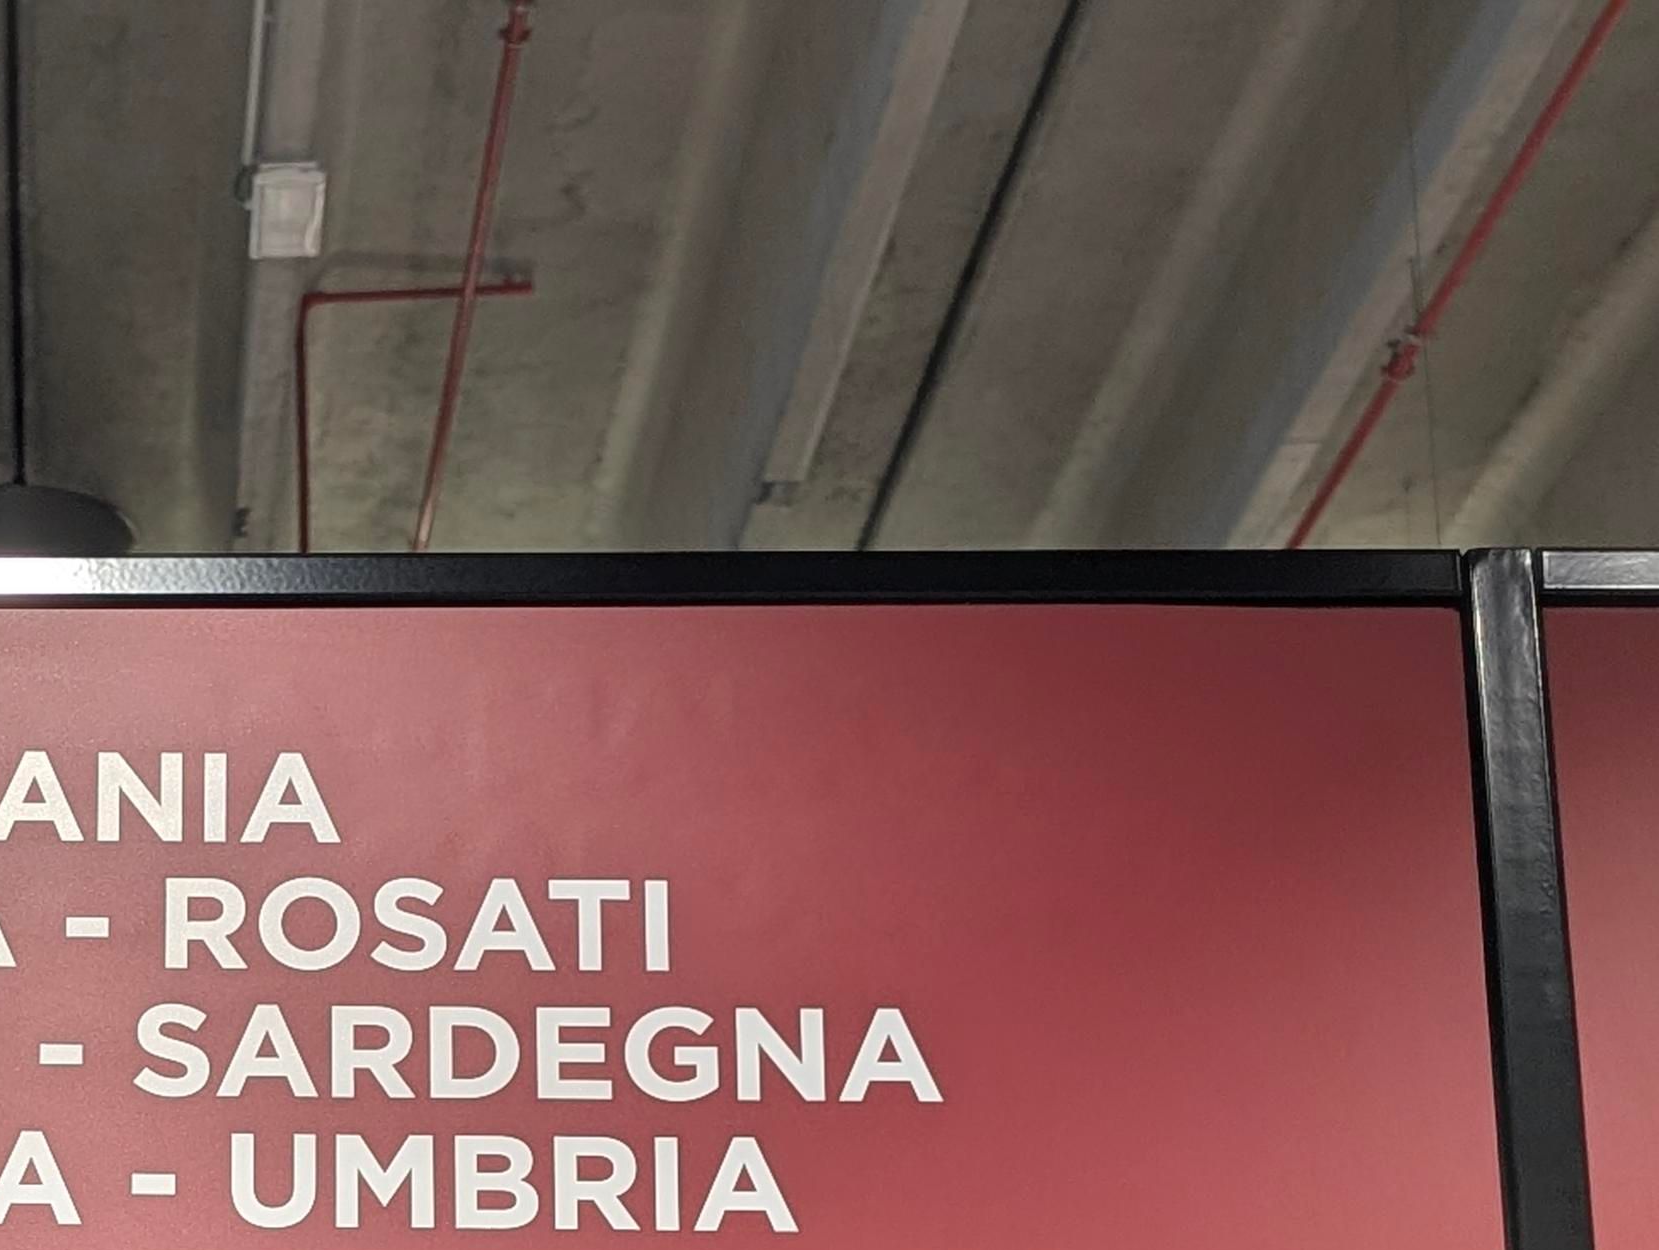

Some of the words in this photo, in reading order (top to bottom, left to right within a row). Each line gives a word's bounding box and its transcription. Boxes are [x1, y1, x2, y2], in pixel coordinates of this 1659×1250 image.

[165, 877, 669, 971] ROSATI
[133, 1003, 943, 1102] SARDEGNA
[231, 1133, 798, 1232] UMBRIA
